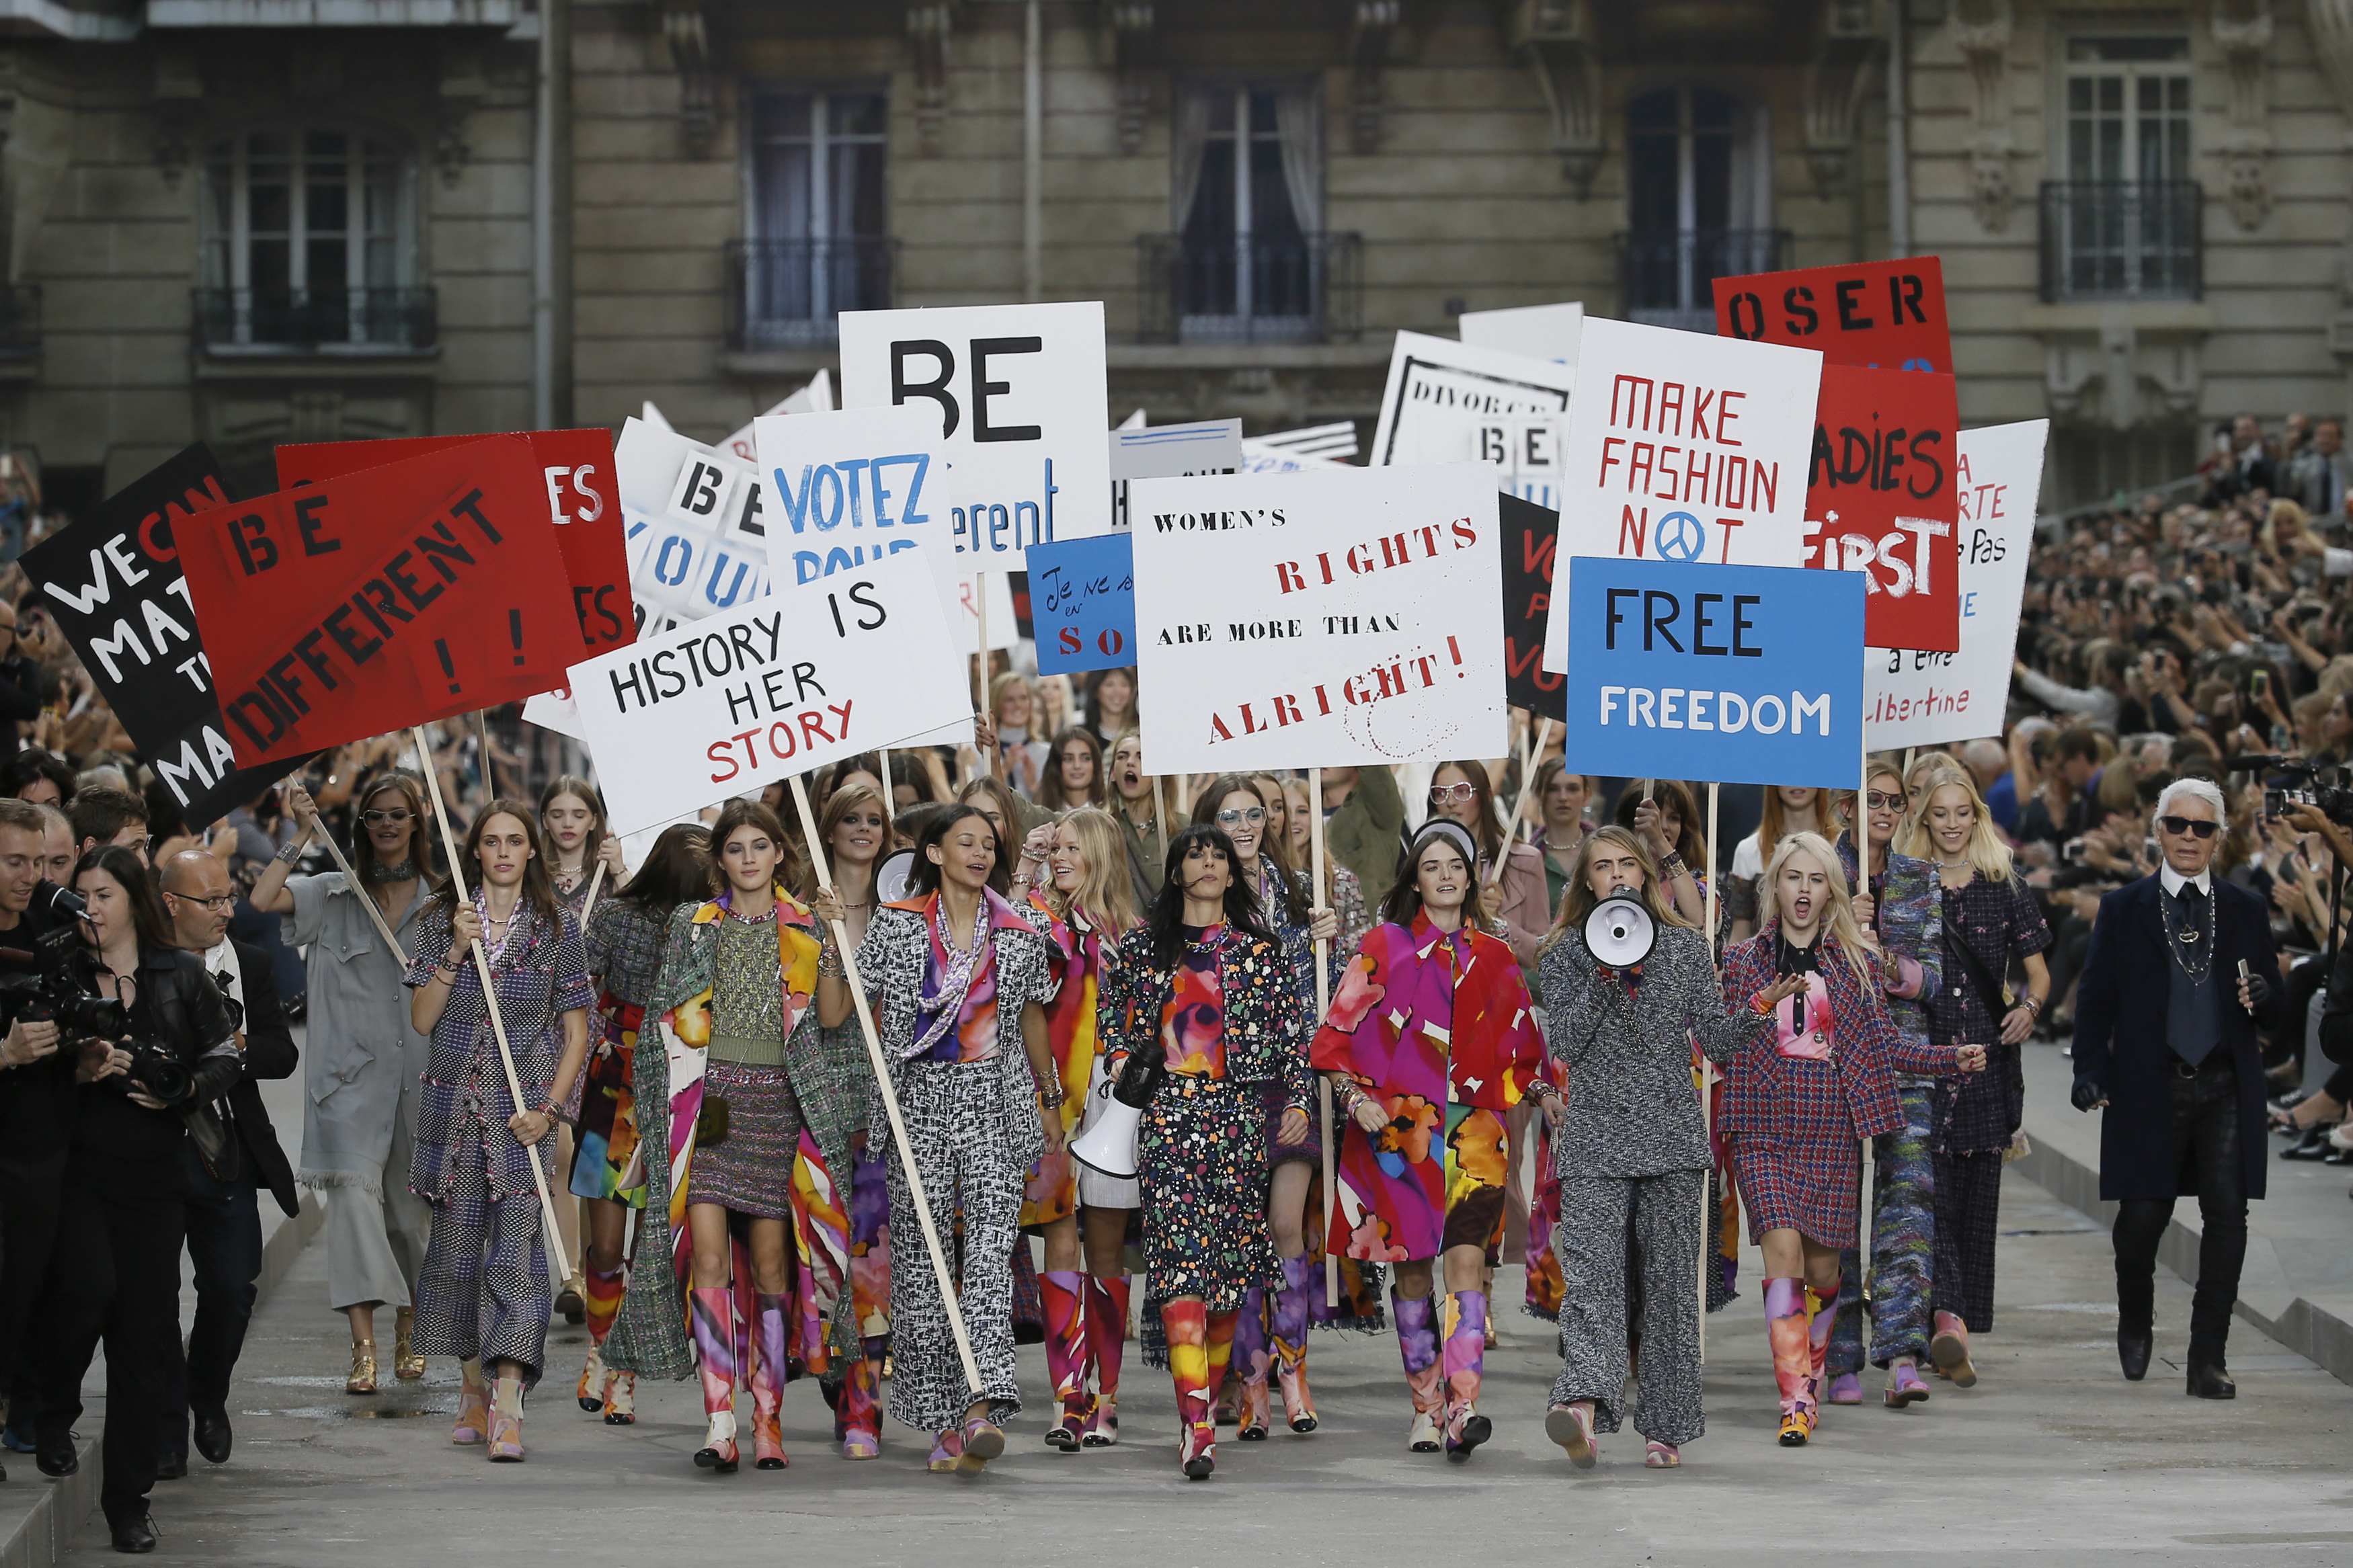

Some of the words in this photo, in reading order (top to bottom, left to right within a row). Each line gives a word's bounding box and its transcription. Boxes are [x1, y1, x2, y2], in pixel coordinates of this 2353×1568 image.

[1729, 274, 1927, 340] OSER
[891, 336, 1042, 442] BE
[1610, 374, 1747, 446] MAKE
[1482, 428, 1550, 465] BE
[1599, 437, 1779, 513] FASHION
[680, 461, 765, 537] BE
[774, 453, 930, 534] VOTEZ
[947, 458, 1059, 552] erent
[44, 533, 149, 614] WE
[227, 494, 341, 577] BE
[1275, 516, 1477, 595] RIGHTS
[1970, 528, 2006, 565] Pas
[226, 488, 503, 753] DIFFERENT
[610, 611, 781, 713] HISTORY
[828, 581, 887, 638] IS
[1157, 623, 1211, 645] ARE
[1228, 619, 1302, 642] MORE
[1322, 613, 1400, 634] THAN
[1606, 588, 1762, 657] FREE
[725, 662, 826, 725] HER
[1208, 635, 1464, 745] ALRIGHT!
[1600, 686, 1831, 737] FREEDOM
[1866, 686, 1969, 723] ibertine
[707, 699, 852, 783] STORY
